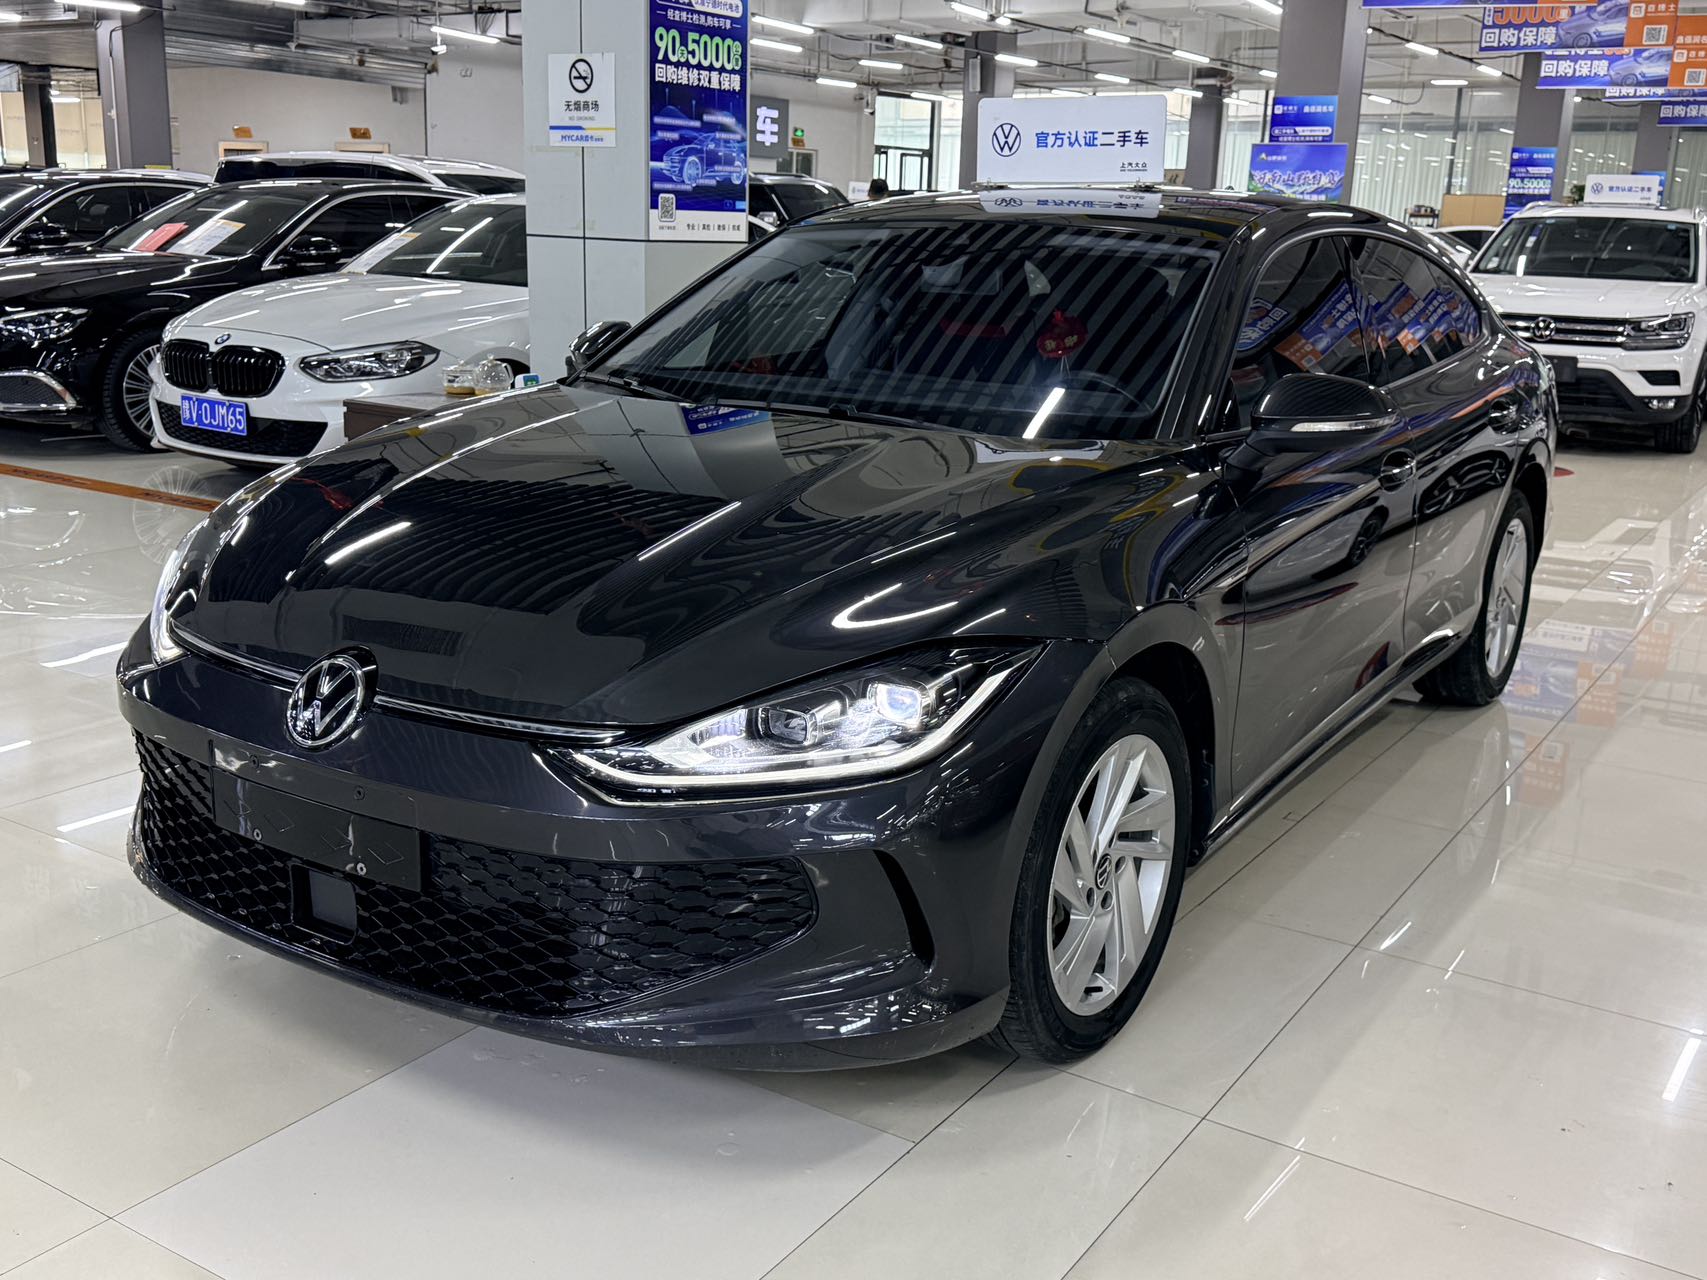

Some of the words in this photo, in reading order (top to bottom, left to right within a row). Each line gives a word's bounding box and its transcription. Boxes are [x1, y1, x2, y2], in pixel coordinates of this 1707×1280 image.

[1481, 26, 1557, 47] 回购保障
[655, 63, 742, 92] 回购维修双重保障
[1540, 60, 1609, 77] 回购保障
[564, 100, 600, 112] 无烟商场
[756, 106, 779, 146] 车
[1035, 130, 1150, 149] 官方认证二手车
[1119, 161, 1147, 169] 上汽大众
